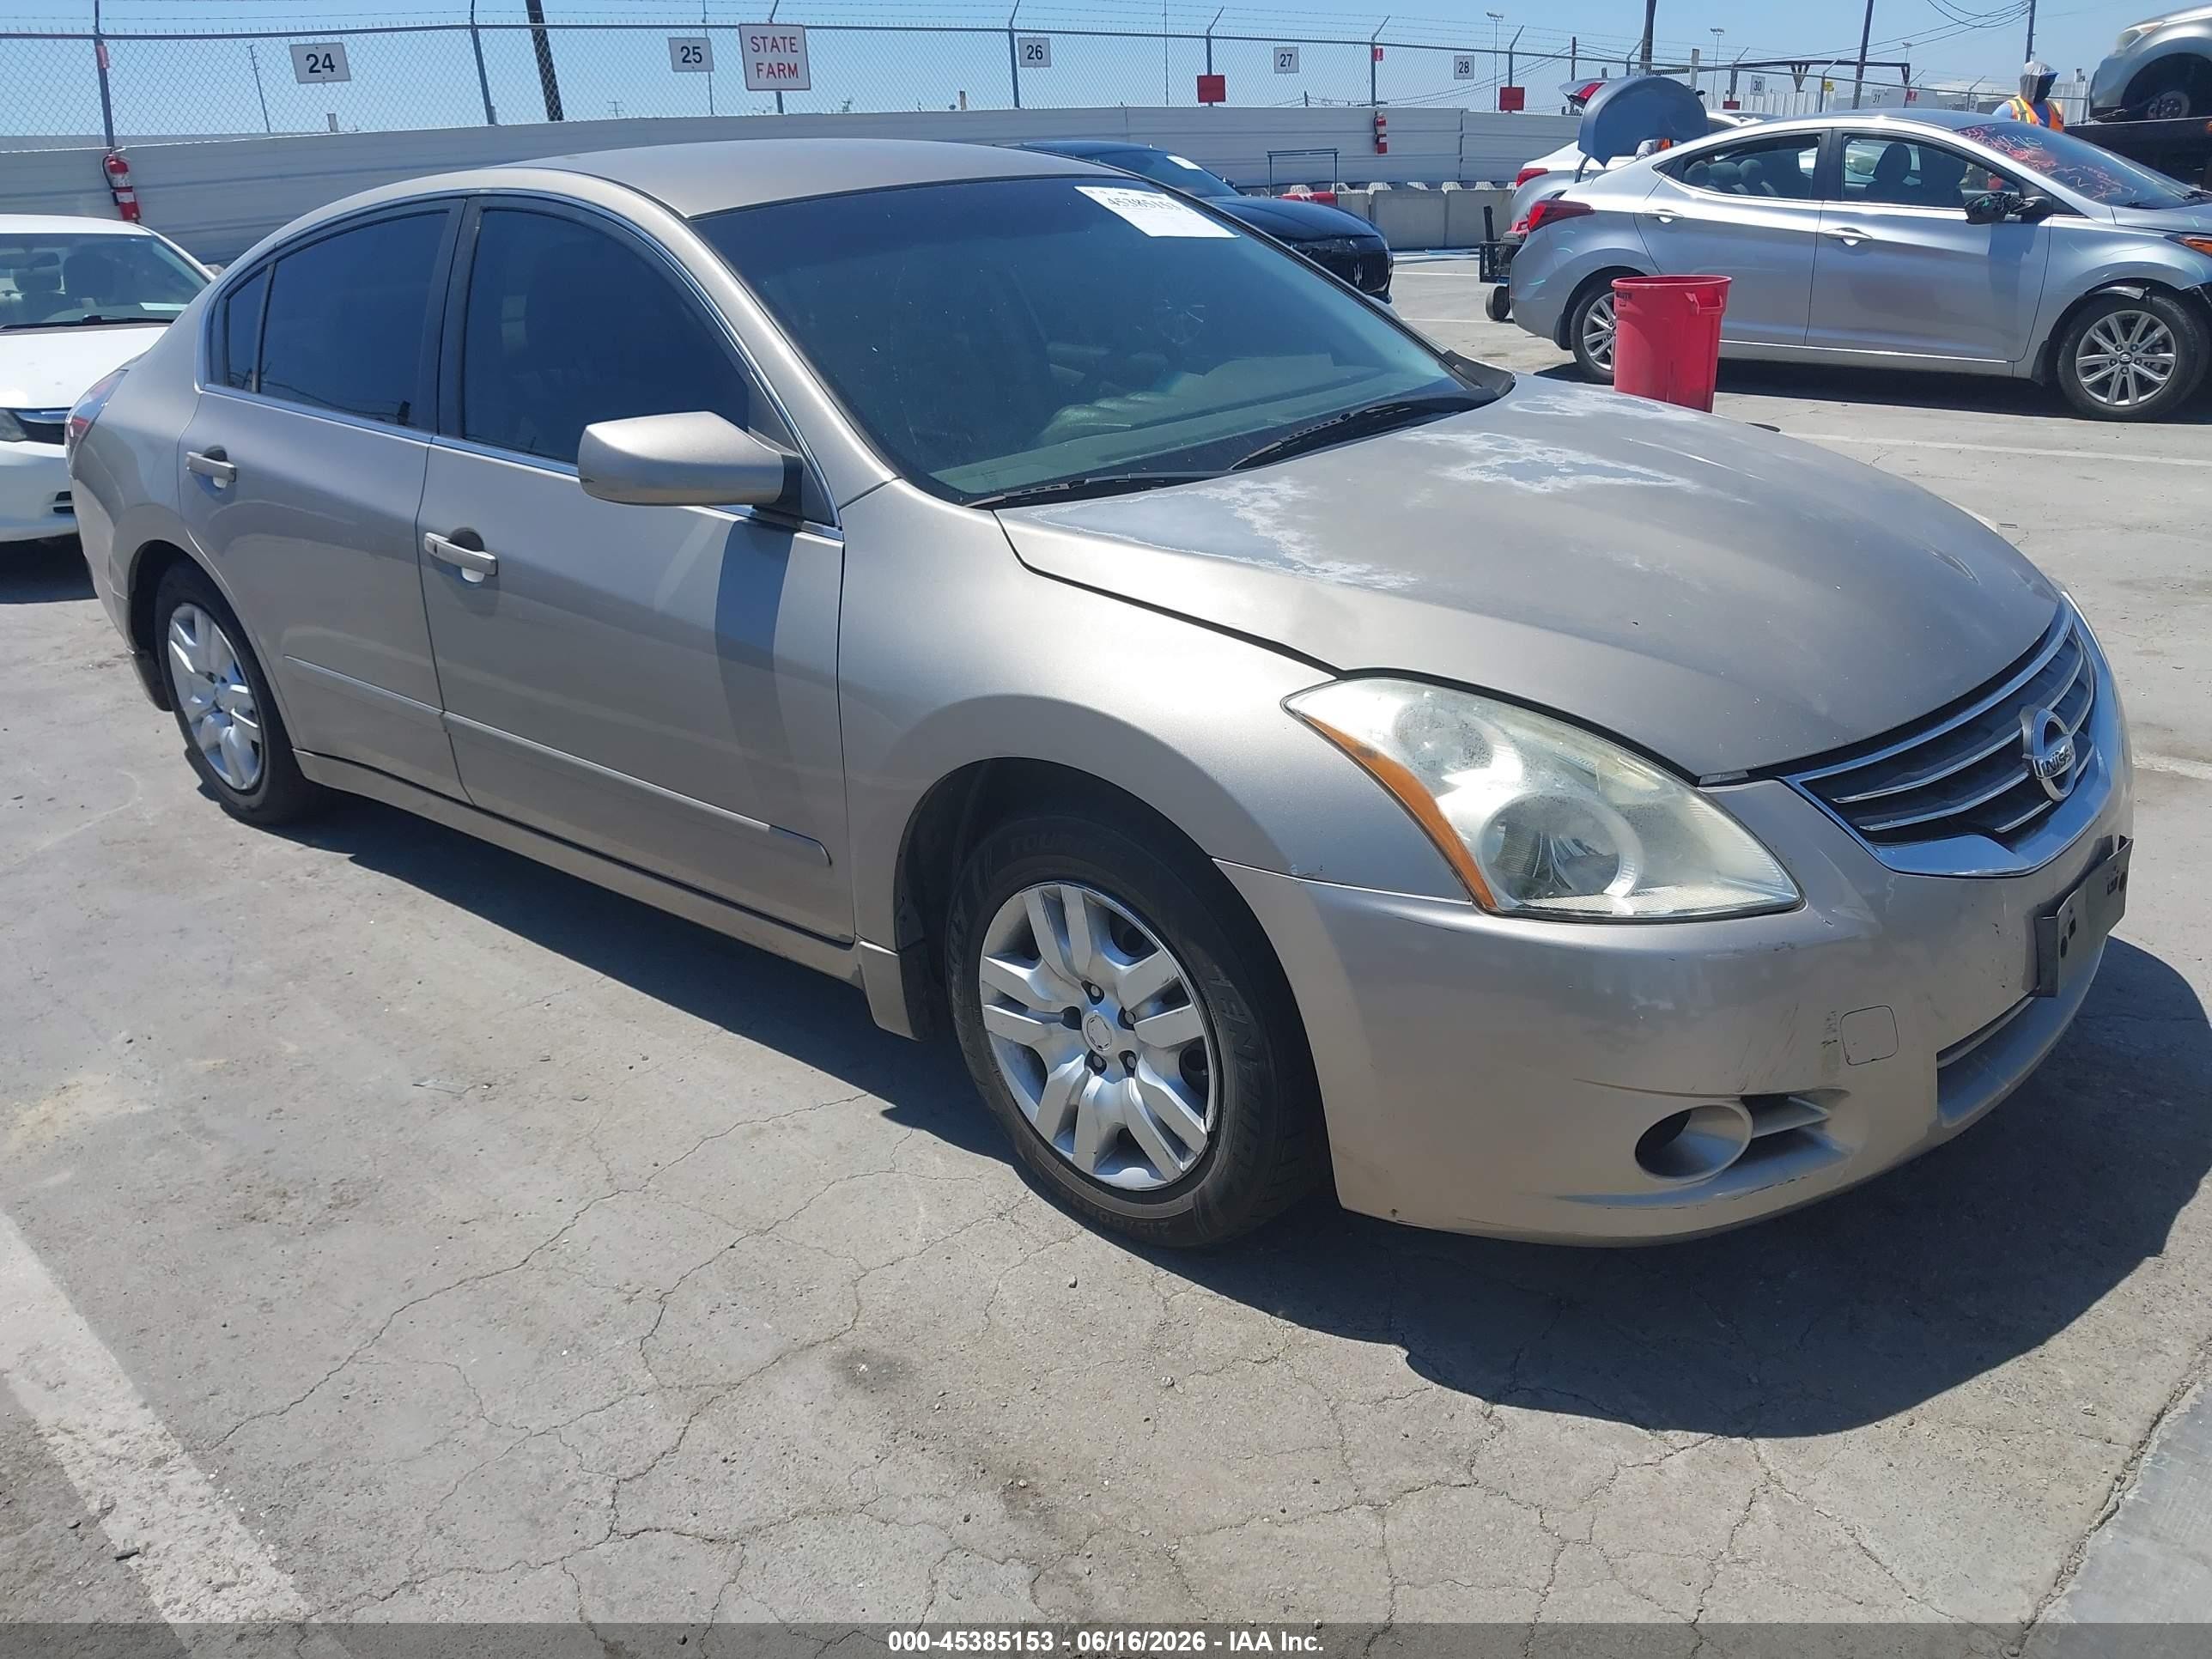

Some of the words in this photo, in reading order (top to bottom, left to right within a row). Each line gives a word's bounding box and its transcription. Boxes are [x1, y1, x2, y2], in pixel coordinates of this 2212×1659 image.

[750, 36, 799, 53] STATE
[680, 46, 702, 64] 25
[1026, 45, 1043, 60] 26
[306, 53, 336, 74] 24
[1279, 53, 1293, 68] 27
[1458, 61, 1470, 74] 28
[756, 63, 799, 79] FARM
[1753, 81, 1762, 91] 30
